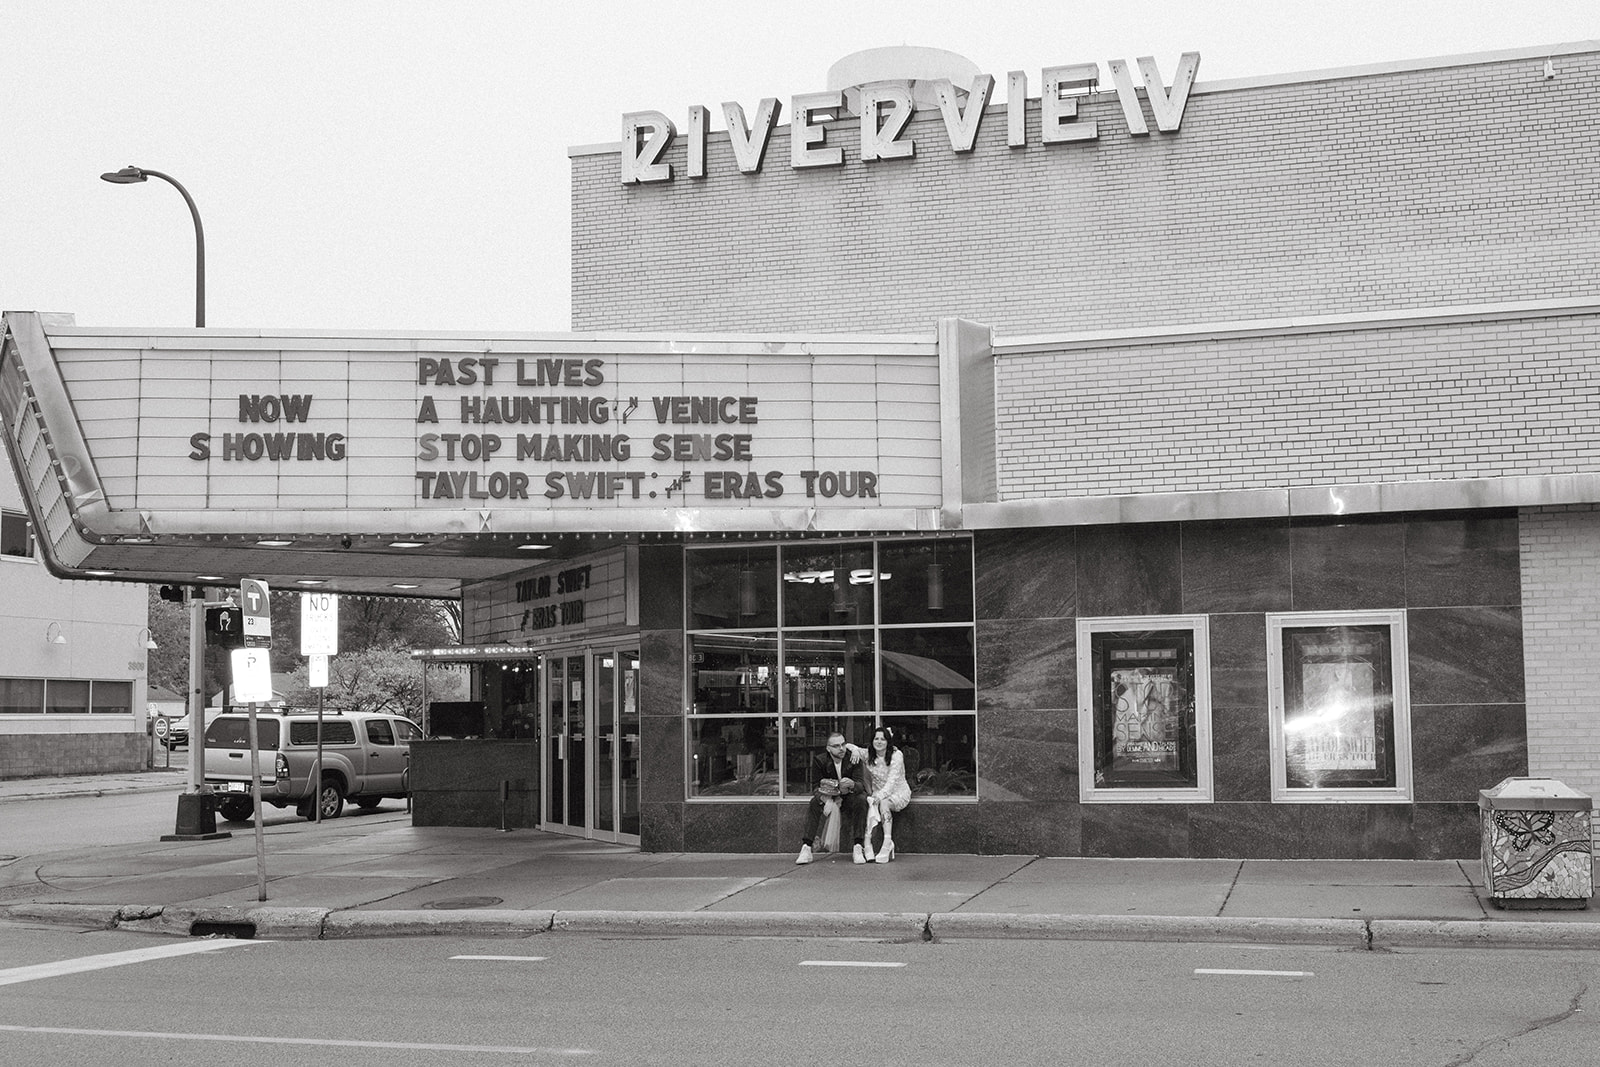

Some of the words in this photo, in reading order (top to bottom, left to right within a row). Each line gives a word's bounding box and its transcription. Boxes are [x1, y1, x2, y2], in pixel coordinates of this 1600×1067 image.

[621, 51, 1201, 186] RIVERVIEW
[419, 357, 499, 386] PAST
[517, 358, 604, 387] LIVES
[239, 395, 313, 423] NOW
[417, 395, 438, 423] A
[461, 396, 609, 424] HAUNTING
[623, 397, 639, 424] IN
[653, 397, 758, 424] VENICE
[417, 433, 502, 462] STOP
[517, 434, 631, 462] MAKING
[652, 434, 752, 462] SENSE
[415, 471, 529, 500] TAYLOR
[665, 471, 692, 499] THE
[704, 471, 783, 499] ERAS
[801, 471, 880, 498] TOUR
[516, 576, 551, 603] TAYLOR
[557, 565, 591, 594] SWIFT
[247, 592, 260, 611] T
[309, 596, 330, 612] NO
[532, 604, 557, 630] ERAS
[560, 599, 584, 626] TOUR
[247, 617, 255, 626] 23
